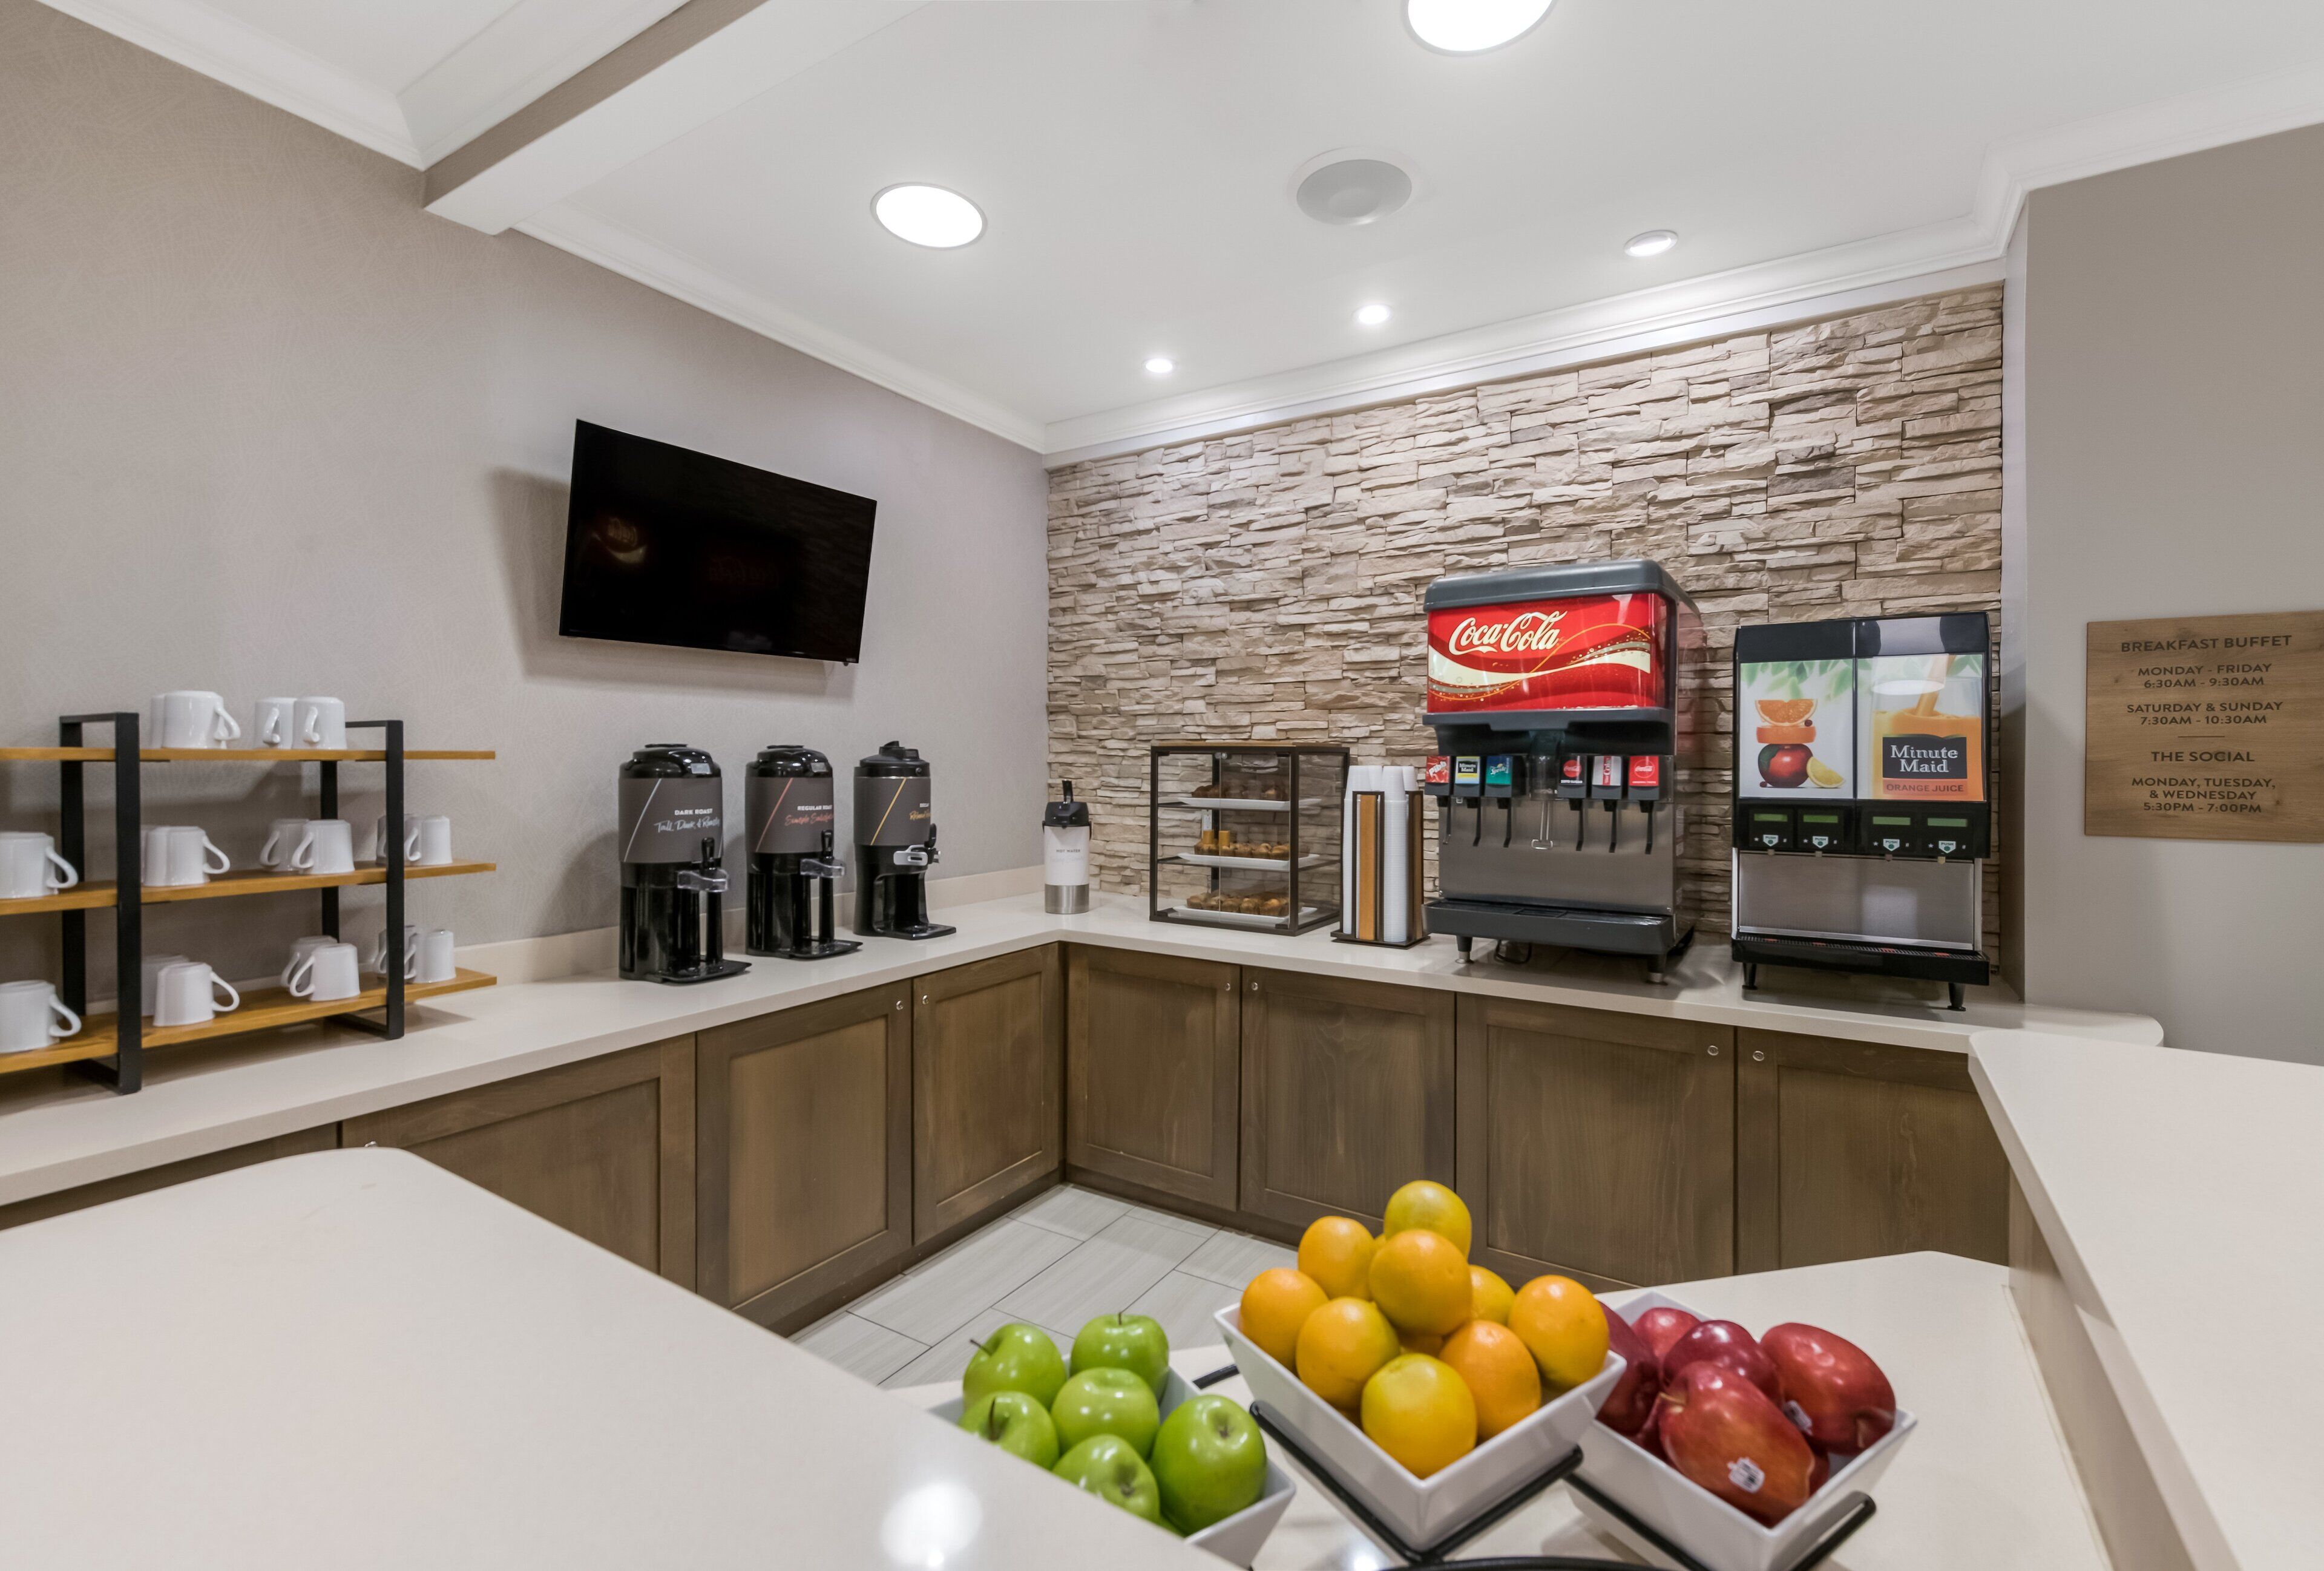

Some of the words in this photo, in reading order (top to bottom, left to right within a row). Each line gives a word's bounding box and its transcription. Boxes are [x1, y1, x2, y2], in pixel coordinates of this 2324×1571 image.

[1448, 610, 1567, 655] Coca-Cola
[2121, 638, 2219, 652] BREAKFAST
[2224, 635, 2293, 649] BUFFET
[2138, 666, 2204, 677] MONDAY
[2217, 663, 2272, 674] FRIDAY
[2144, 678, 2196, 689] 6:30AM
[2209, 676, 2265, 687] 9:30AM
[2127, 703, 2202, 713] SATURDAY
[2205, 703, 2216, 712] &
[2219, 701, 2283, 712] SUNDAY
[2140, 715, 2192, 726] 7:30AM
[2205, 715, 2267, 724] 10:30AM
[1890, 745, 1958, 759] Minute
[2150, 751, 2184, 762] THE
[2188, 751, 2256, 762] SOCIAL
[1899, 759, 1949, 773] Maid
[1886, 784, 1930, 792] ORANGE
[2132, 777, 2201, 789] MONDAY,
[2203, 778, 2276, 790] TUESDAY,
[2149, 790, 2159, 799] &
[2162, 790, 2257, 800] WEDNESDAY
[2144, 802, 2194, 812] 5:30PM
[2207, 803, 2262, 813] 7:00PM
